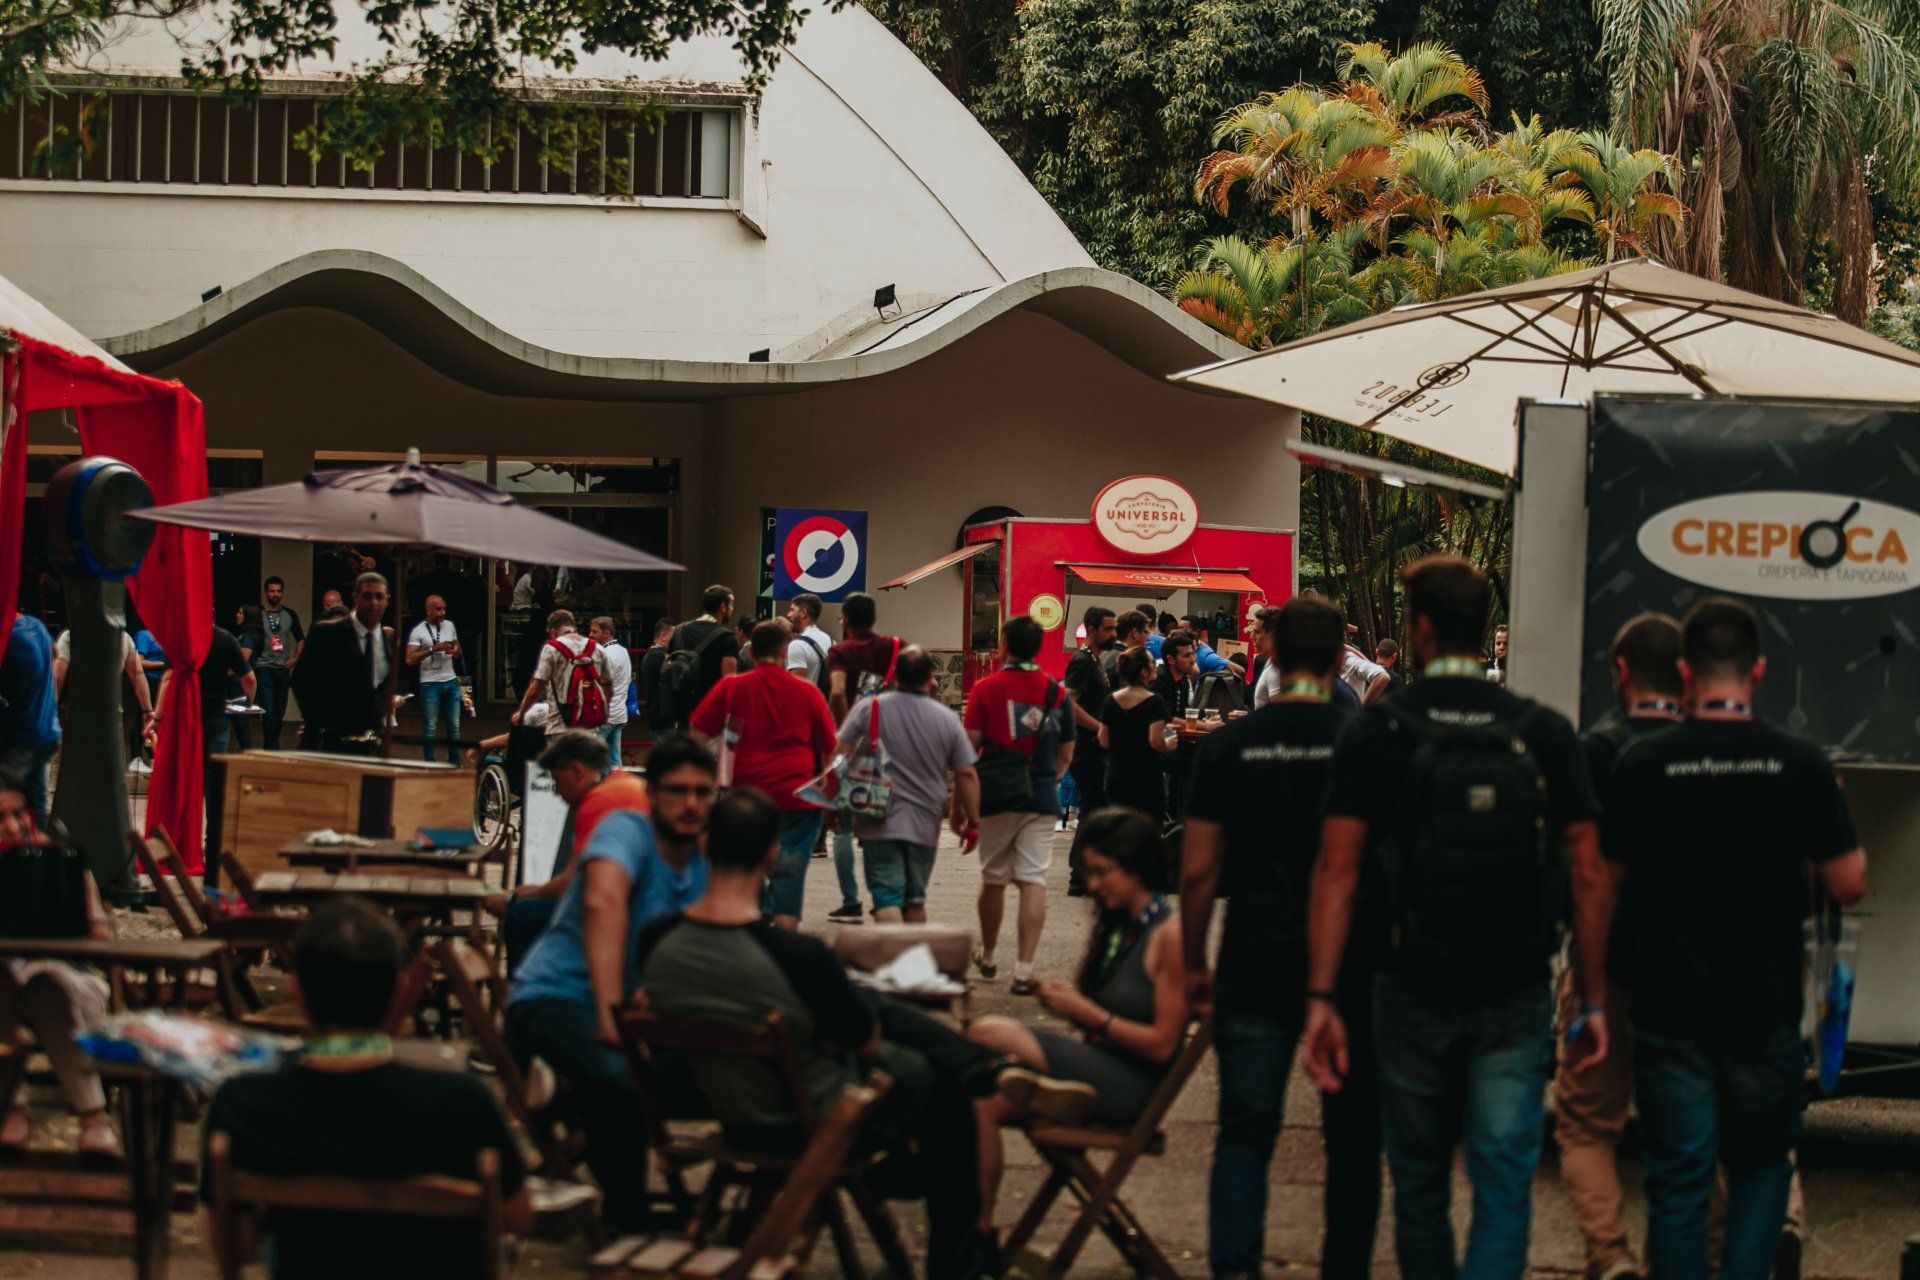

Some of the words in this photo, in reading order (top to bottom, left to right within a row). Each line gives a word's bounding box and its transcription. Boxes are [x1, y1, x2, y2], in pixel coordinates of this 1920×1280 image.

[1107, 510, 1186, 522] UNIVERSAL
[1672, 502, 1908, 569] CREPIOCA
[1757, 564, 1819, 581] CREPERIA
[1836, 567, 1908, 584] TAPIOCARIA
